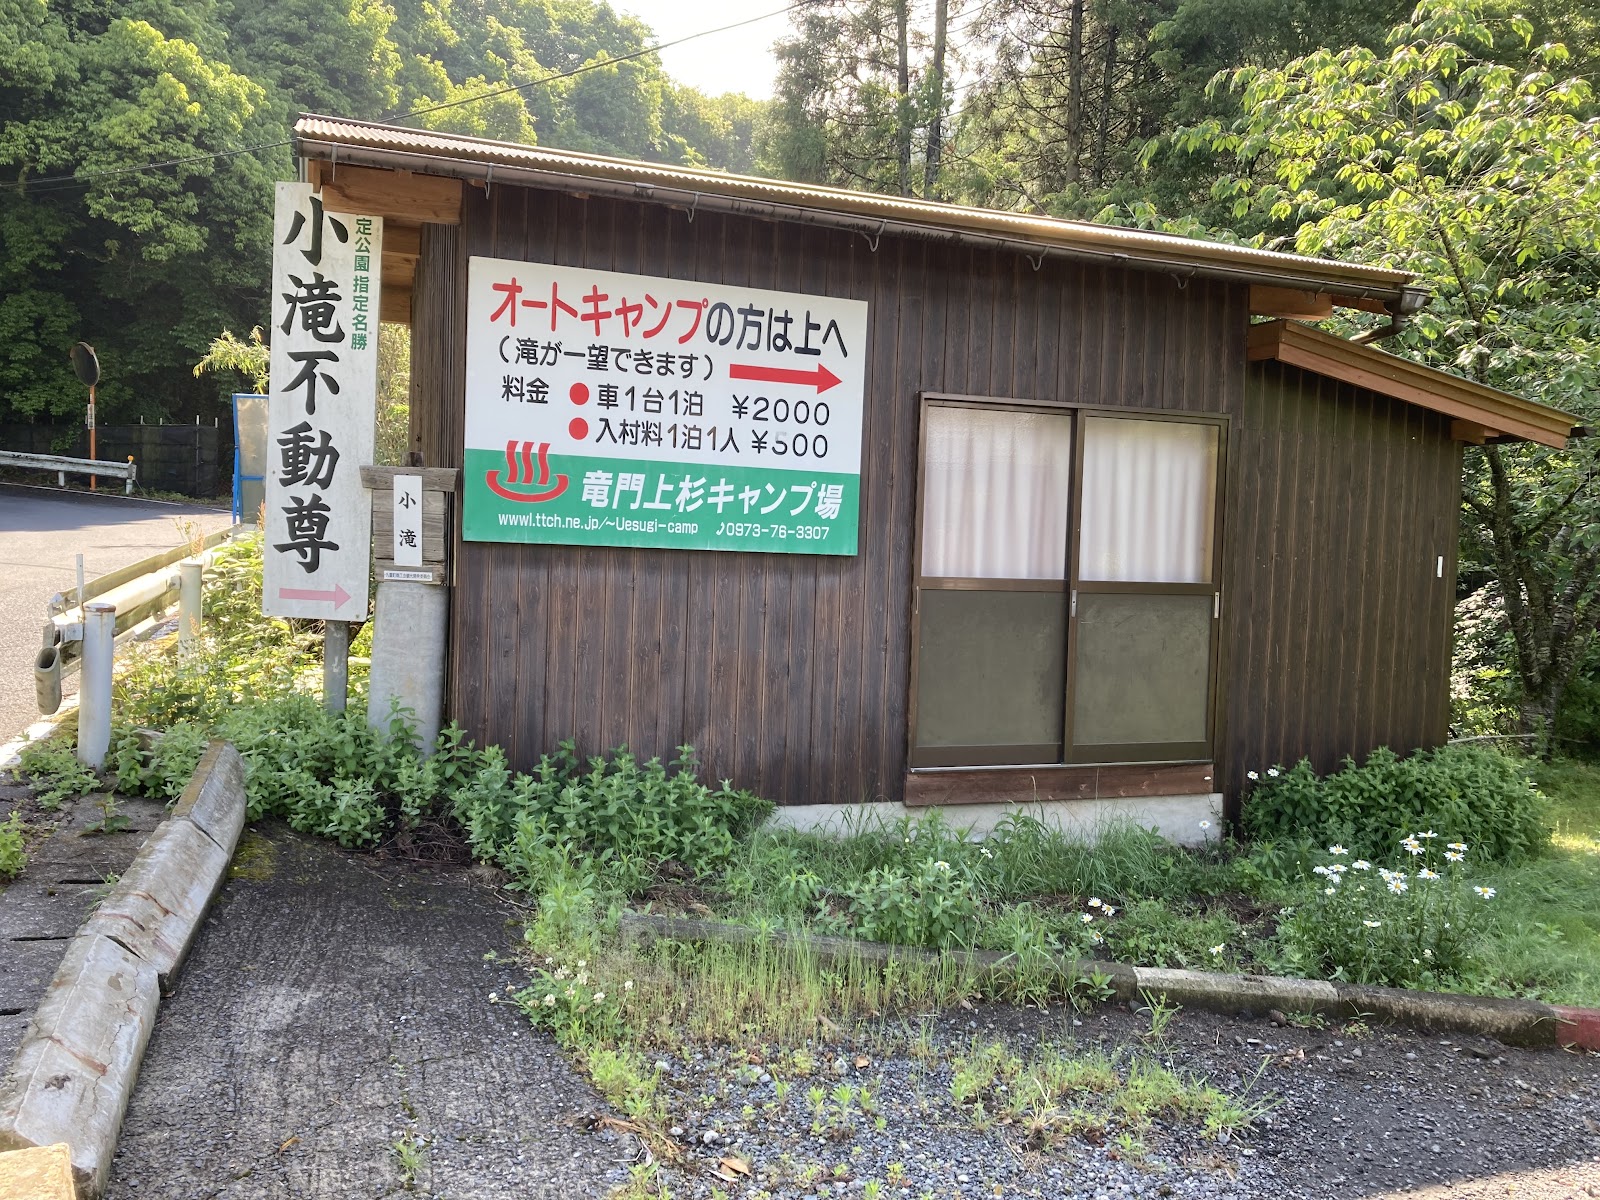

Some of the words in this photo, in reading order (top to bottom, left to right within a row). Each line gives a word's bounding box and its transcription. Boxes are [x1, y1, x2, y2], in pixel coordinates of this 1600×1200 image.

[351, 217, 372, 351] 定公園指定名勝
[489, 276, 848, 359] オートキャンプの方は上へ
[273, 196, 349, 574] 小滝不動尊
[501, 373, 550, 405] 料金
[732, 394, 830, 426] ¥2000
[595, 417, 740, 453] 入村料1泊1人
[751, 429, 829, 458] ¥500
[398, 490, 418, 548] 小滝
[581, 469, 844, 520] 竜門上杉キャンプ場
[726, 522, 830, 540] 0973-76-3307
